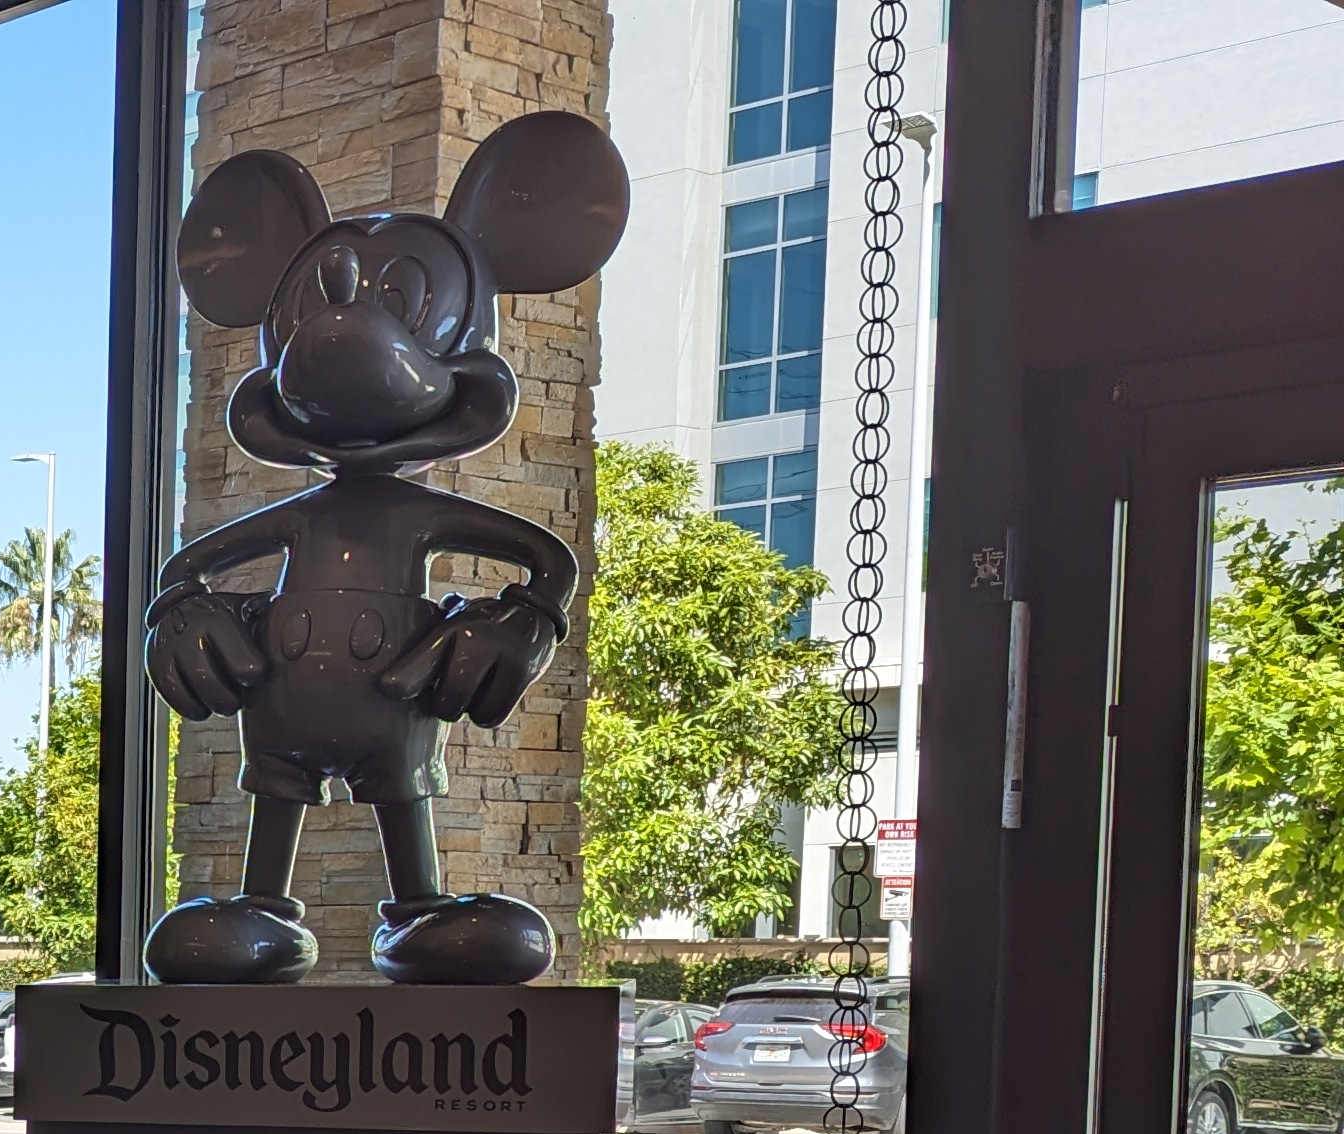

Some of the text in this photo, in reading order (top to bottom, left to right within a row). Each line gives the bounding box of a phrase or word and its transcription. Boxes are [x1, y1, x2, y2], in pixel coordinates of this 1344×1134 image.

[905, 822, 917, 830] YOU
[78, 1002, 533, 1113] Disneyland
[435, 1099, 527, 1112] RESORT
